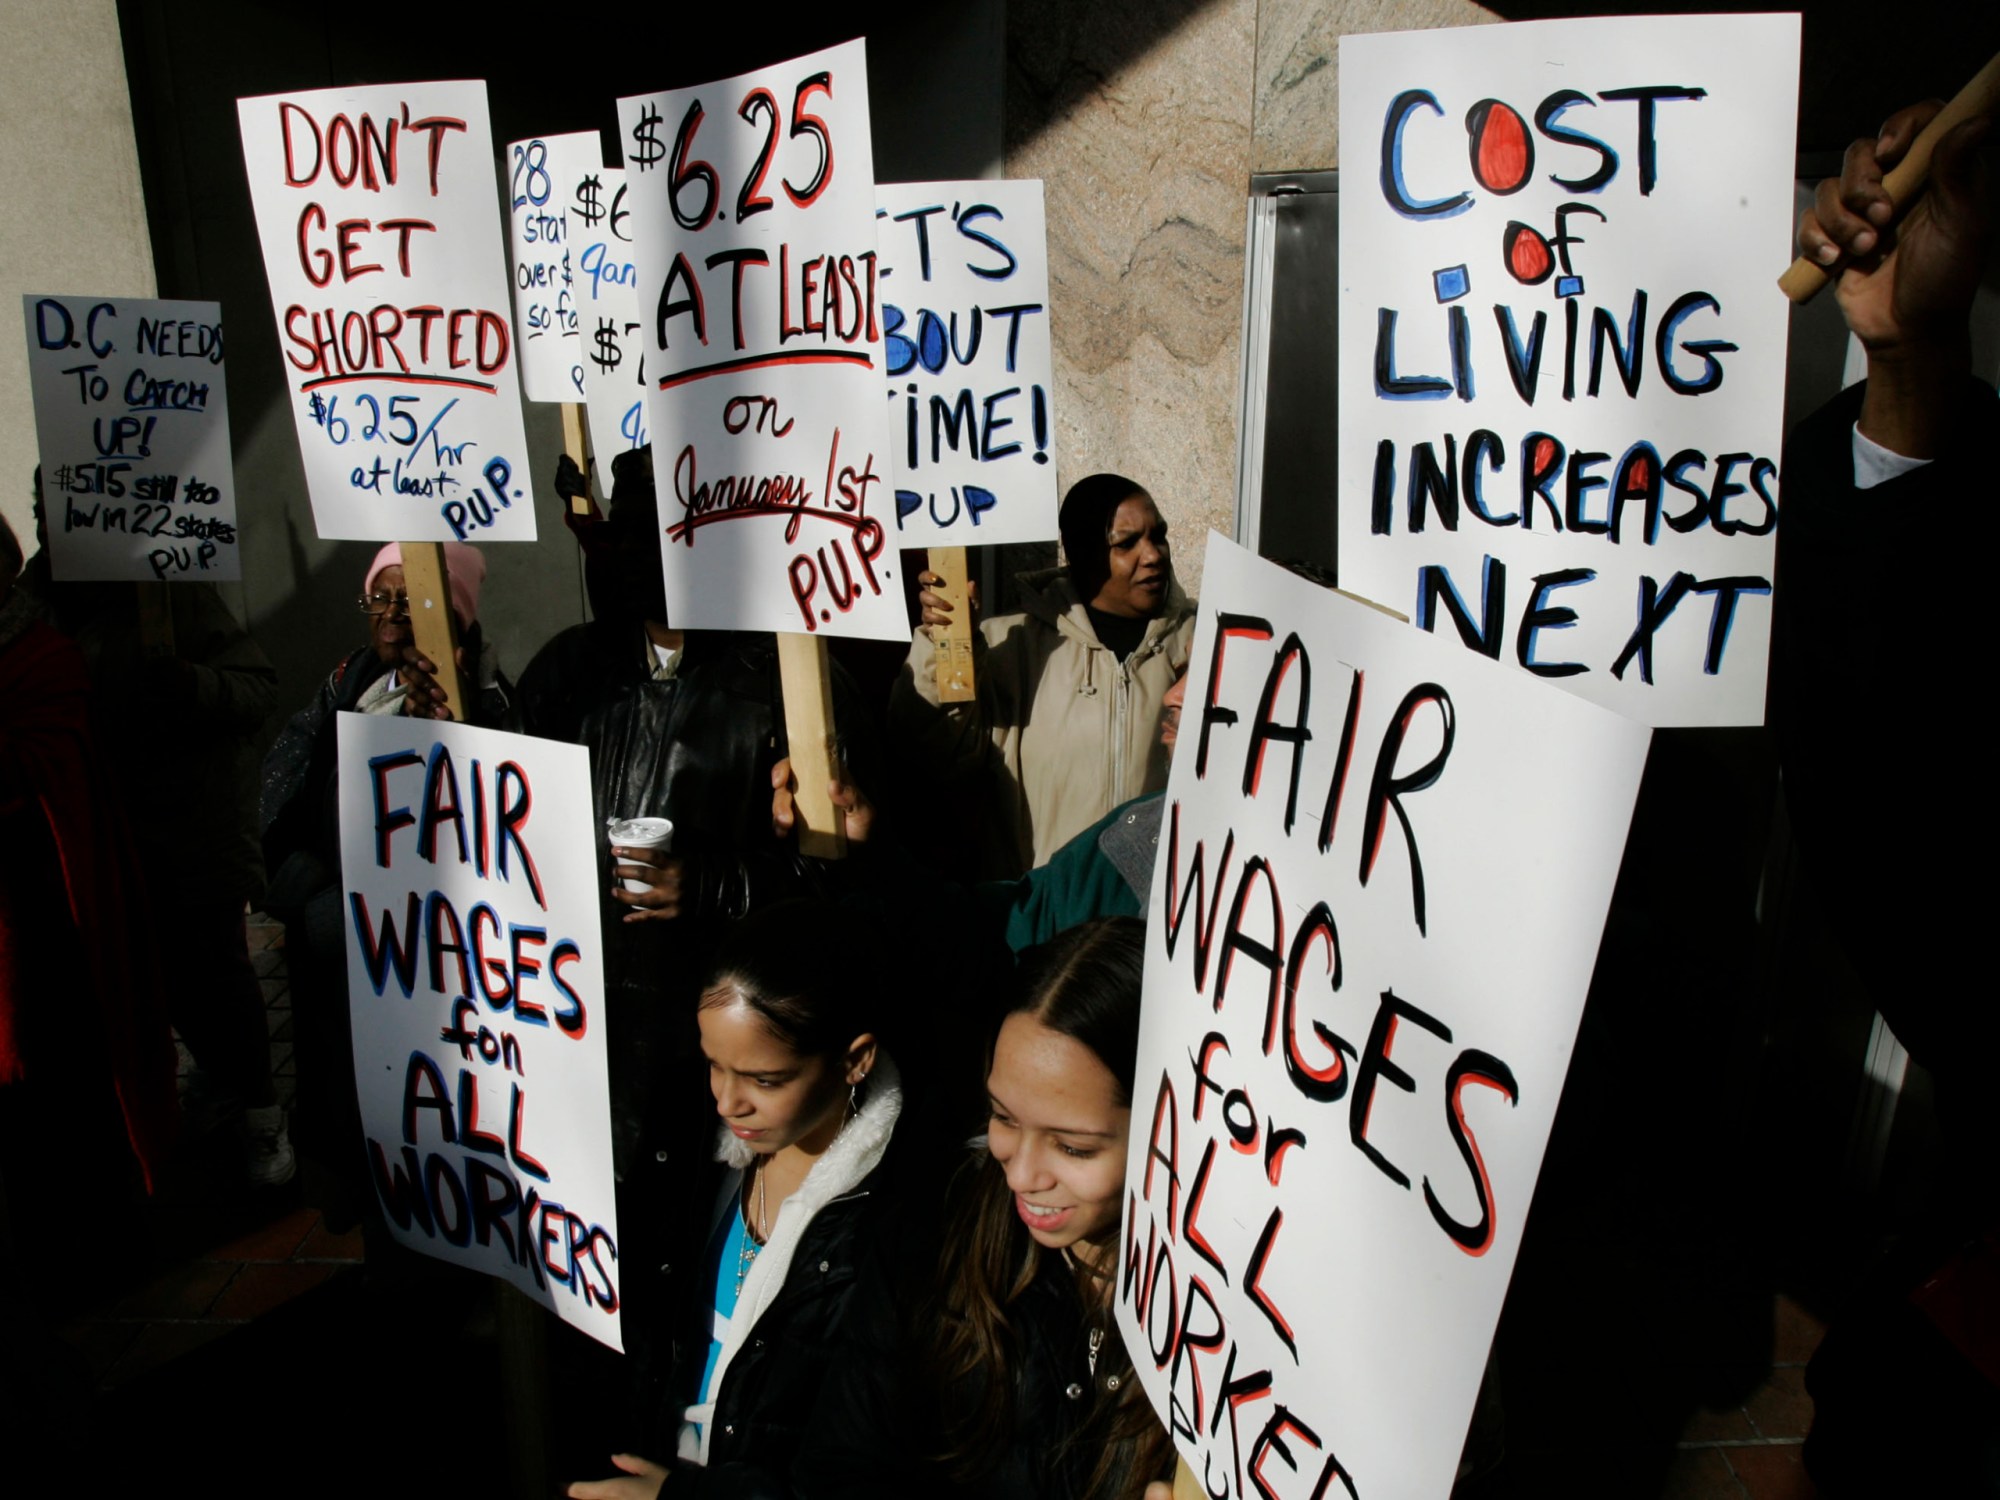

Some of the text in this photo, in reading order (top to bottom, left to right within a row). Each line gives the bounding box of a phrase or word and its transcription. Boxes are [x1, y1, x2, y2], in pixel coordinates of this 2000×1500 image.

[278, 101, 467, 196] DON'T
[512, 139, 551, 213] 28
[629, 71, 834, 231] $6.25
[1379, 85, 1708, 222] COST
[298, 202, 437, 288] GET
[523, 206, 567, 244] stat
[571, 173, 633, 242] $6
[876, 201, 1018, 282] T'S
[518, 262, 557, 290] over
[527, 289, 579, 331] so fa
[656, 243, 880, 351] AT LEAST
[137, 317, 224, 365] NEEDS
[284, 303, 510, 376] SHORTED
[882, 303, 1043, 376] BOUT
[124, 368, 209, 409] CATCH
[723, 395, 794, 438] on
[94, 416, 158, 457] UP!
[350, 455, 390, 496] at
[64, 497, 236, 544] low in 22 states
[131, 475, 179, 504] still
[184, 476, 221, 505] too
[441, 455, 523, 541] P.U.P.
[674, 444, 813, 548] January
[895, 484, 997, 531] PUP
[1371, 429, 1779, 545] INCREASES
[788, 516, 891, 632] P.U.P.
[1416, 553, 1771, 686] NEXT
[1196, 609, 1456, 939] FAIR
[368, 742, 548, 912] FAIR
[350, 889, 587, 1040] WAGES
[1164, 800, 1519, 1257] WAGES
[403, 1050, 550, 1183] ALL
[1188, 1031, 1306, 1186] for
[367, 1136, 620, 1314] WORKERS
[1144, 1067, 1299, 1366] ALL
[1123, 1186, 1360, 1500] WORKE
